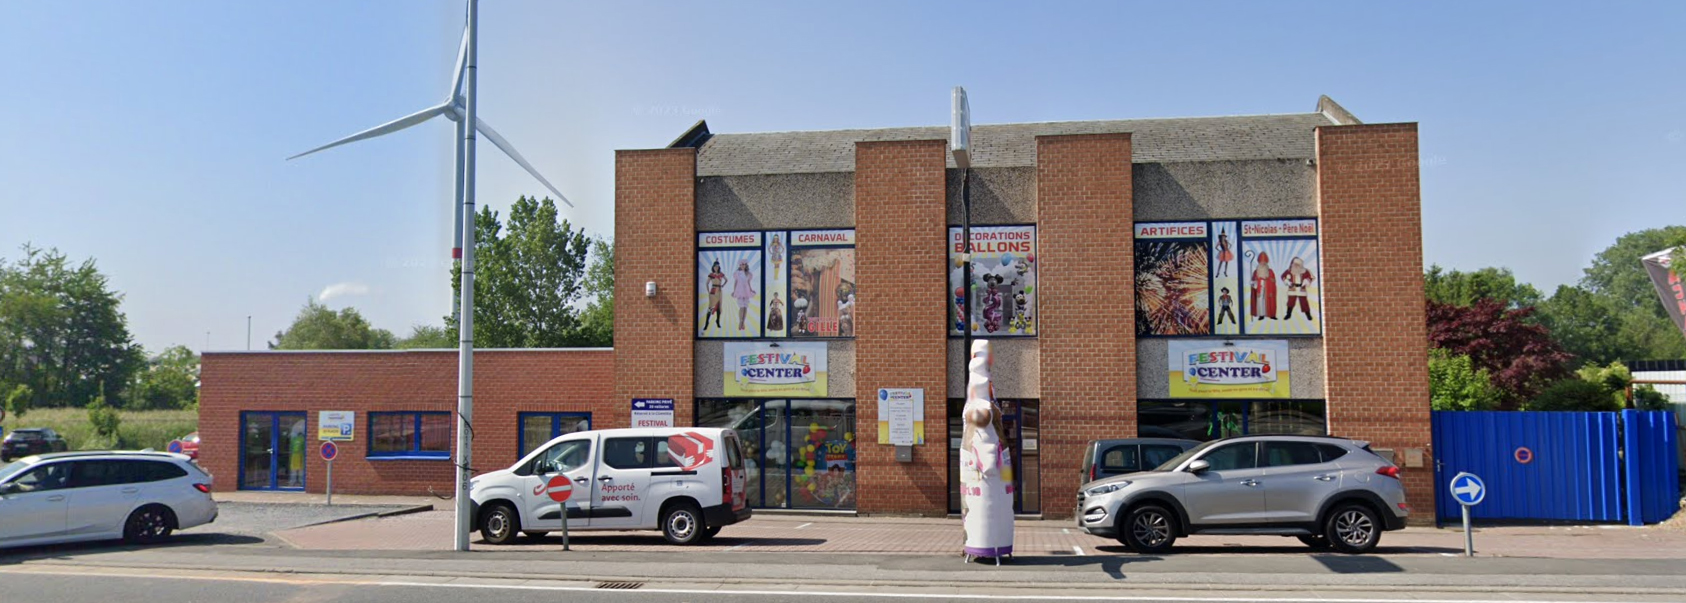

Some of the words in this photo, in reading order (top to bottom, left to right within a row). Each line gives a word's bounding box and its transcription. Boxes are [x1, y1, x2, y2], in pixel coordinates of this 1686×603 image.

[1140, 226, 1204, 236] ARTIFICES
[1244, 224, 1278, 235] St-Nicolas
[1282, 224, 1298, 234] Père
[1299, 223, 1314, 233] Noël
[705, 235, 755, 245] COSTUMES
[798, 233, 848, 242] CARNAVAL
[808, 321, 838, 333] GILLE
[740, 353, 810, 367] FESTIVAL
[1188, 350, 1270, 366] FESTIVAL
[747, 368, 802, 378] CENTER
[1197, 367, 1261, 378] CENTER
[826, 442, 848, 454] TOY
[601, 483, 635, 494] Apporté
[622, 494, 641, 502] soin.
